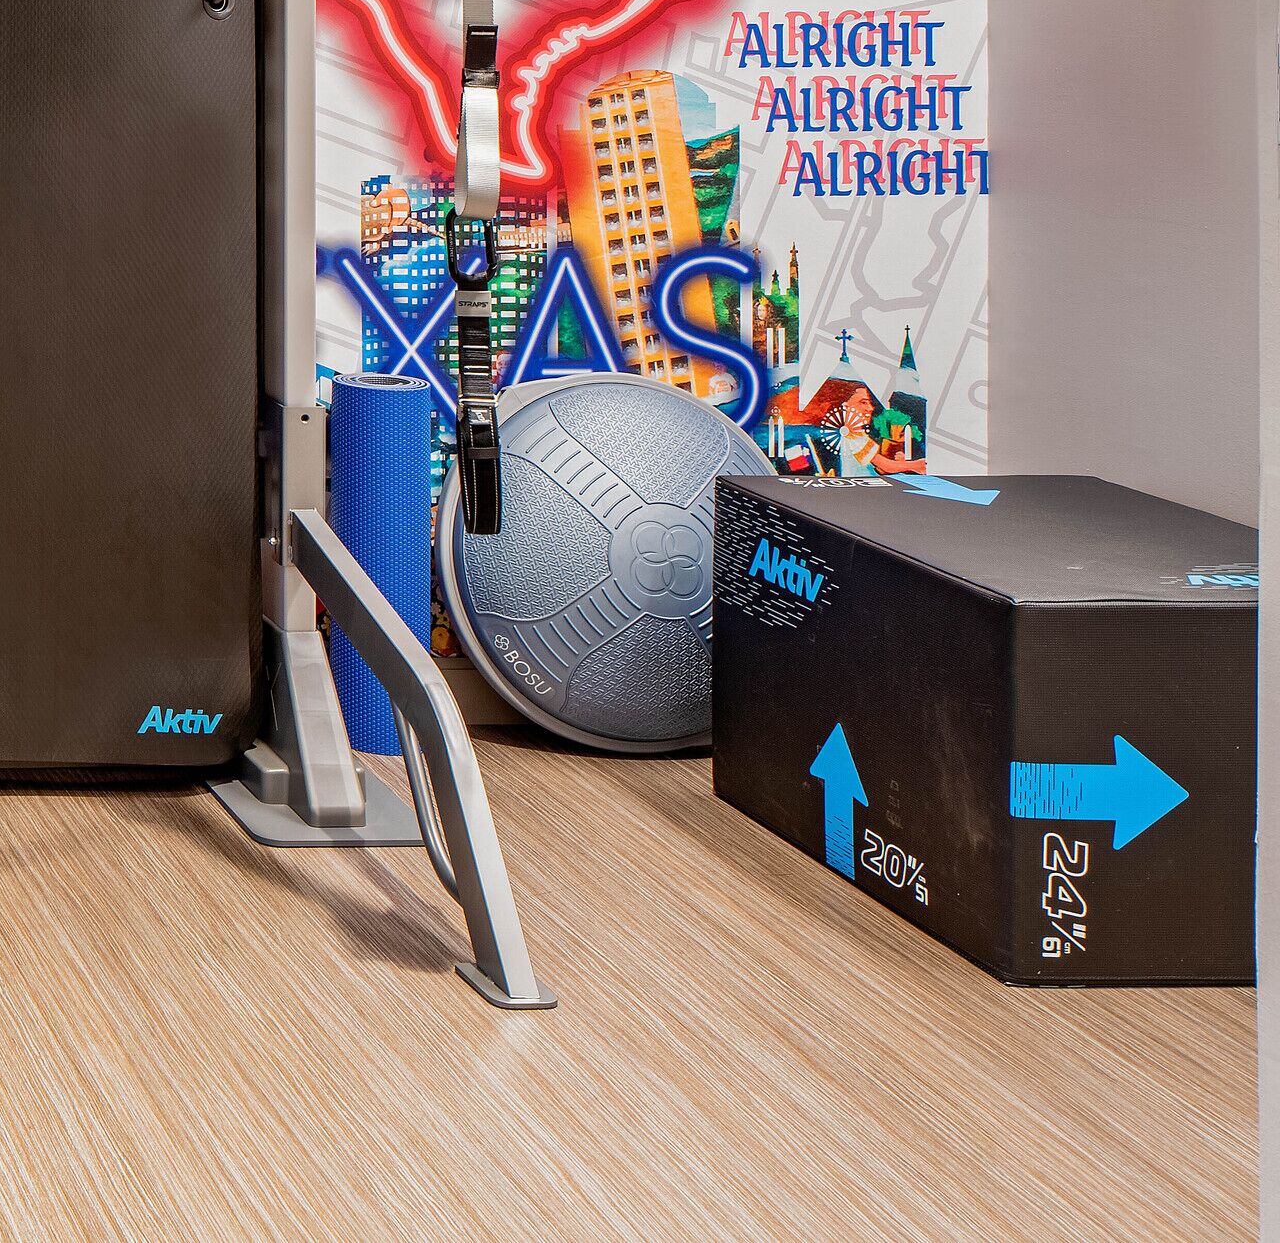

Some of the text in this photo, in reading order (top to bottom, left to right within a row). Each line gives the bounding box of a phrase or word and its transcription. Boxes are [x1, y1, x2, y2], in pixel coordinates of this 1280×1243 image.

[738, 20, 945, 69] ALRIGHT
[765, 85, 973, 133] ALRIGHT
[792, 149, 989, 197] ALRIGHT
[748, 538, 825, 603] Aktiv
[503, 649, 552, 695] BOSU
[137, 705, 224, 734] Aktiv
